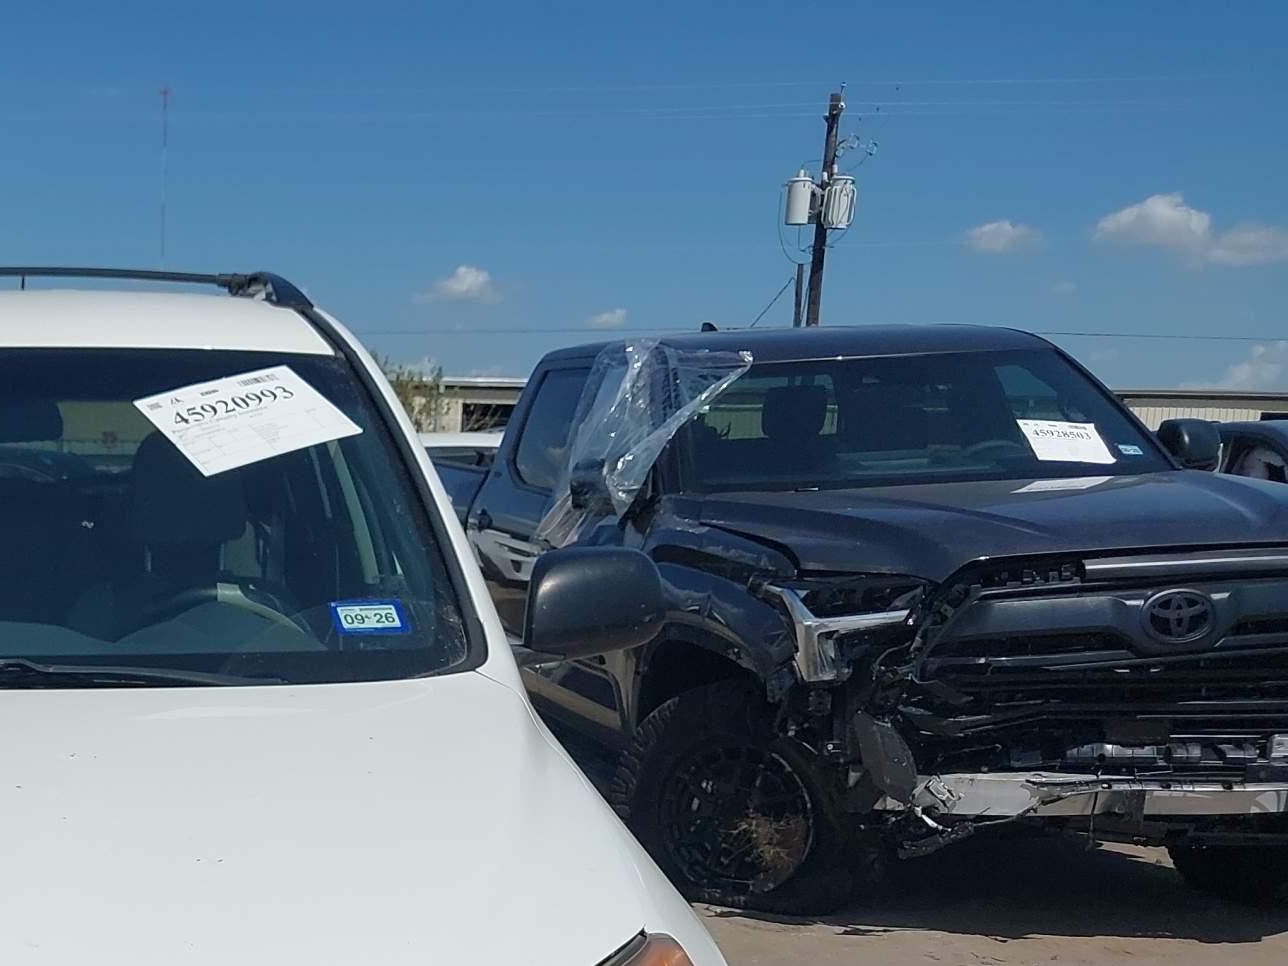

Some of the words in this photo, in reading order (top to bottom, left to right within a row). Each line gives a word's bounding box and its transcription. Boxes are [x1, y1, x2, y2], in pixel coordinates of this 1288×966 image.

[173, 385, 295, 426] 45920993
[343, 613, 366, 625] 09
[373, 612, 396, 624] 26
